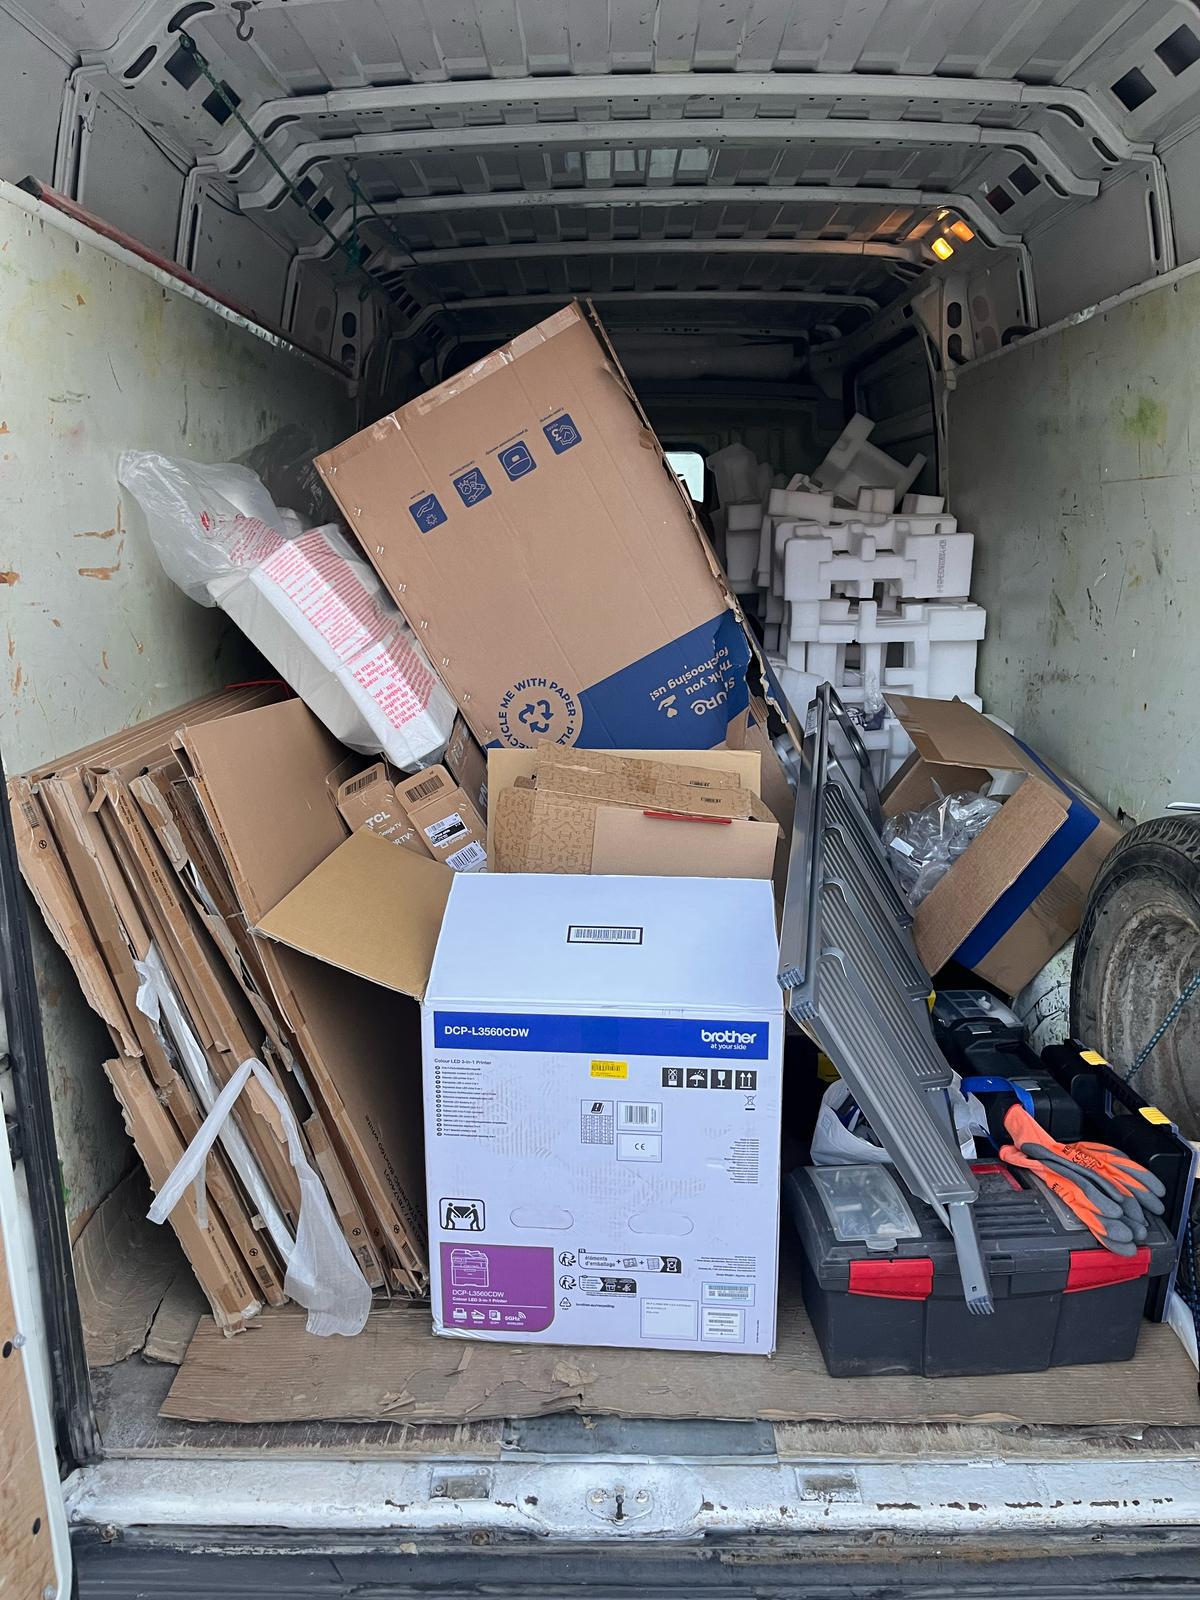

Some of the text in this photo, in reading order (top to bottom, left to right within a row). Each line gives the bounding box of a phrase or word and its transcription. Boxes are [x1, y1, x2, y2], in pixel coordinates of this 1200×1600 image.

[667, 657, 719, 690] choosing
[649, 686, 668, 701] us!
[685, 677, 708, 695] you
[500, 690, 515, 709] ME
[513, 678, 547, 692] WITH
[549, 681, 576, 717] PAPER
[365, 811, 391, 827] TCL
[444, 1025, 530, 1038] DCP-L3560CDW
[701, 1029, 757, 1044] brother
[452, 1289, 505, 1298] DCP-L3560CDW
